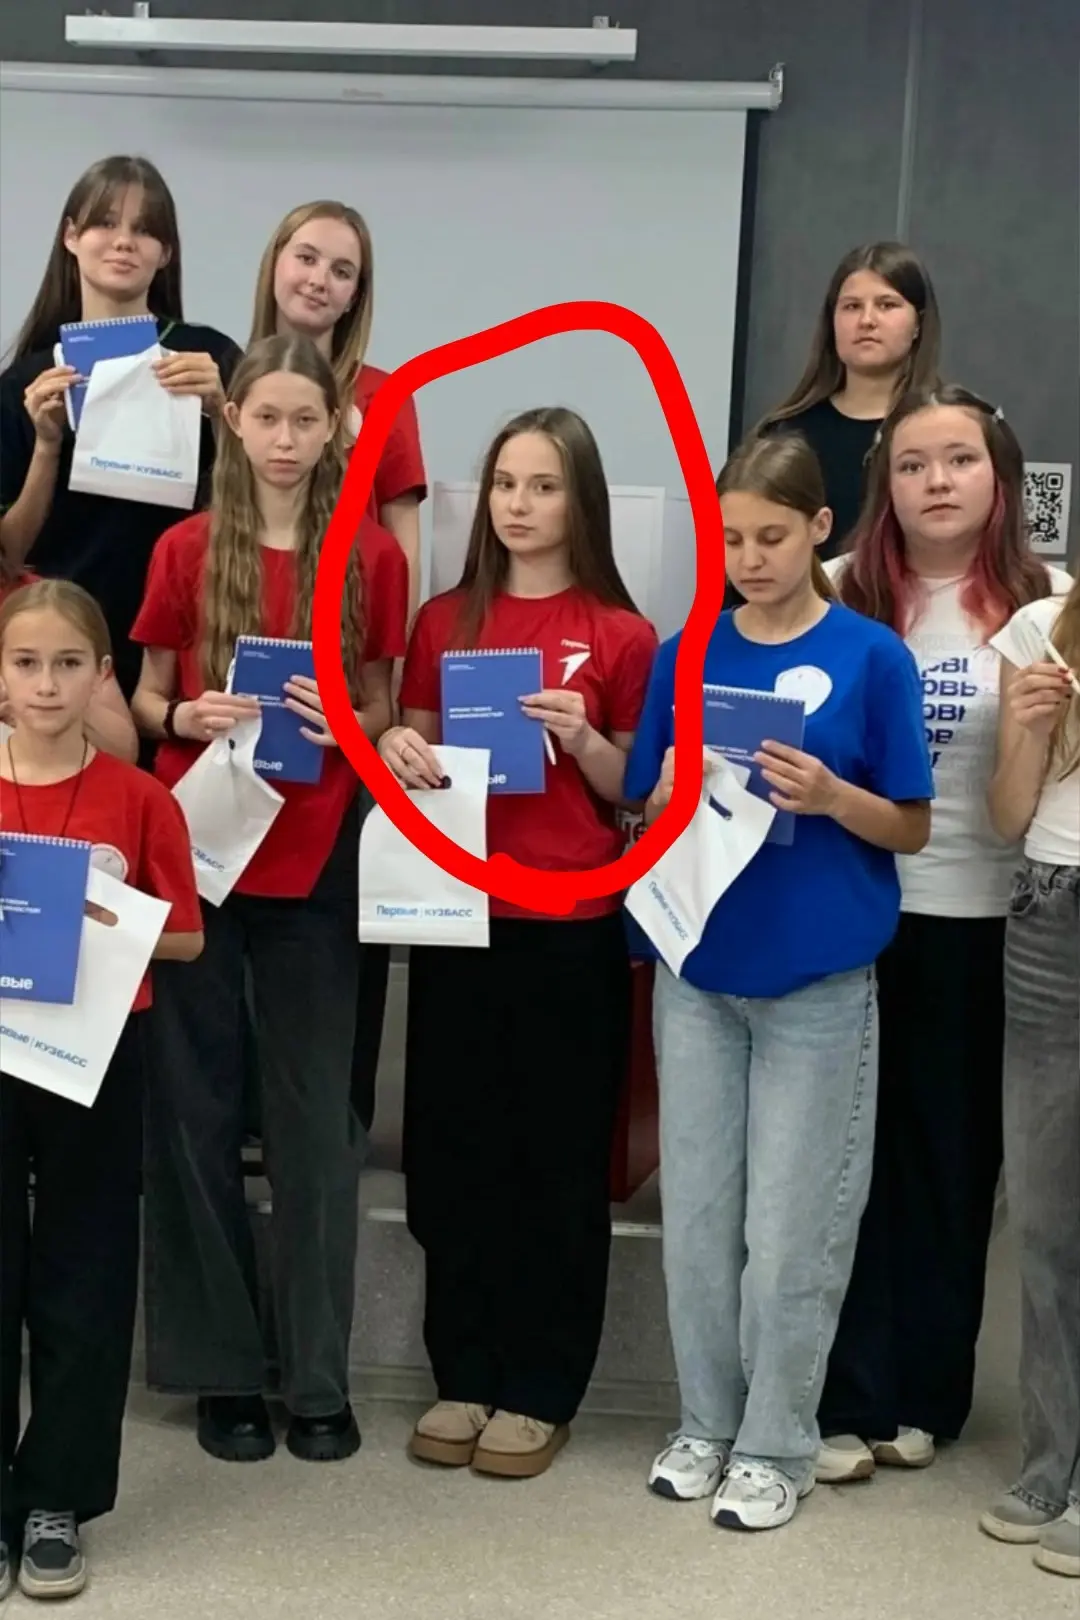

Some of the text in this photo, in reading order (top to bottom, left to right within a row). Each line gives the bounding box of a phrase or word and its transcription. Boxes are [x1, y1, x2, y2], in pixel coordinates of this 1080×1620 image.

[136, 464, 183, 479] КУЗБАСС
[376, 904, 474, 918] Первые КУЗБАСС
[34, 1039, 88, 1068] КУЗБАСС
